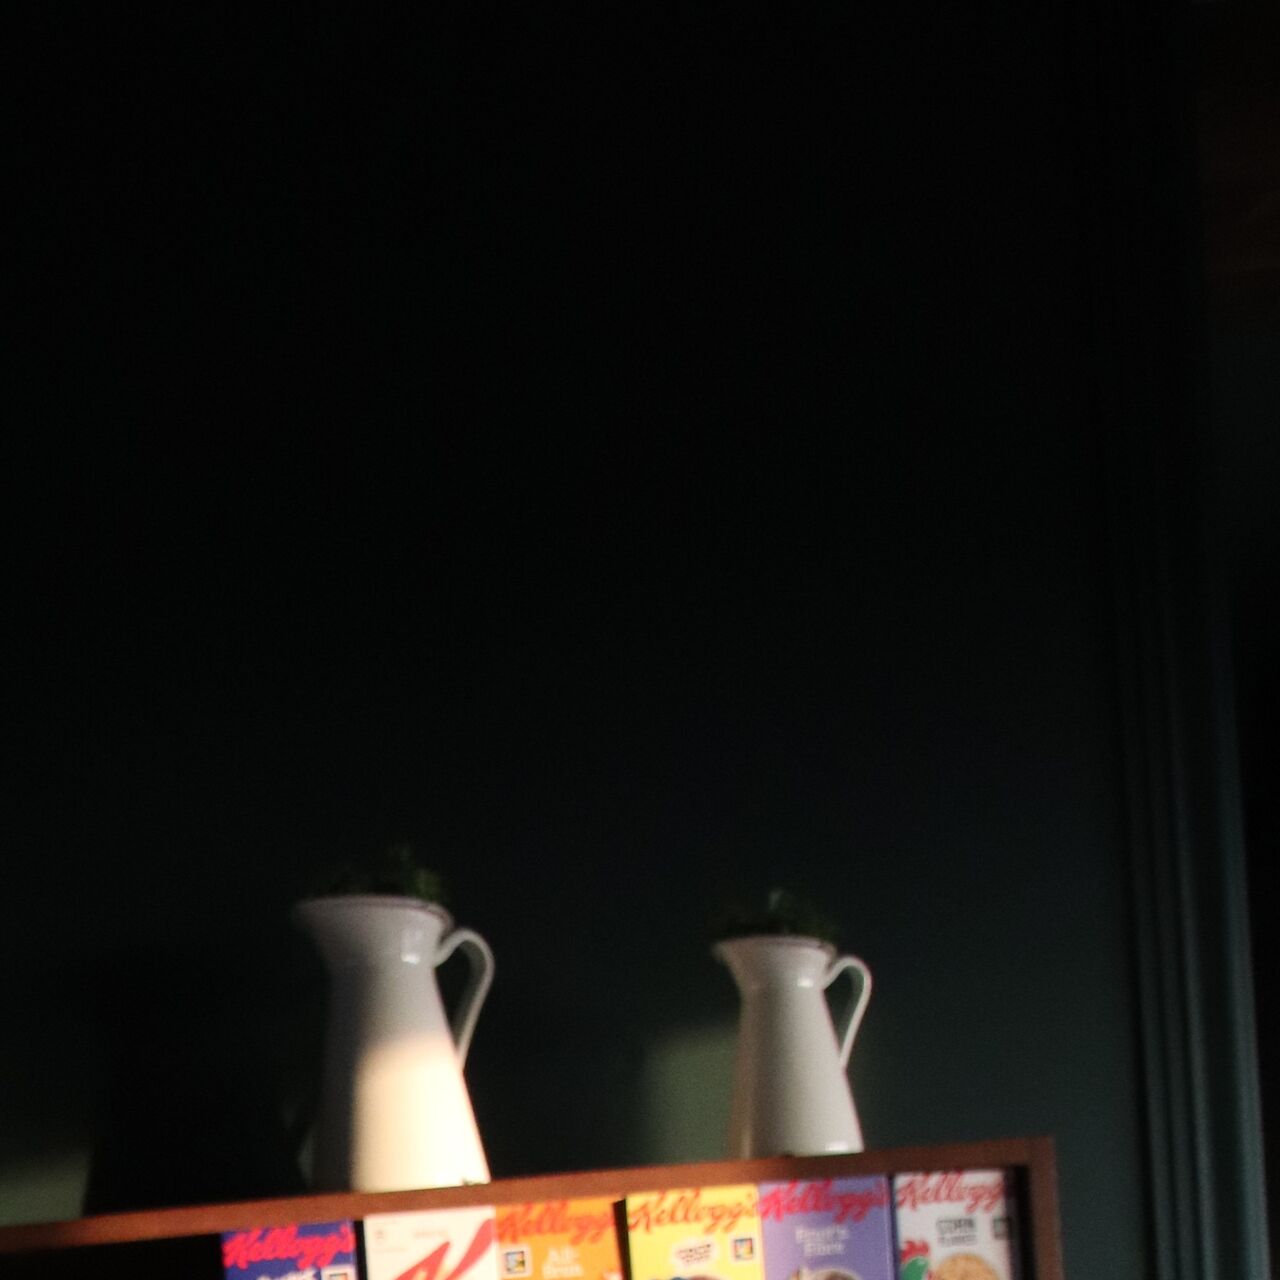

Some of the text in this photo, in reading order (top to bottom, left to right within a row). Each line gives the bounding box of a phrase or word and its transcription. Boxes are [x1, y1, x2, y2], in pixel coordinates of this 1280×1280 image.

[628, 1186, 757, 1234] Kellogg's
[896, 1168, 1005, 1213] Kellogg
[497, 1199, 614, 1246] Kellogg
